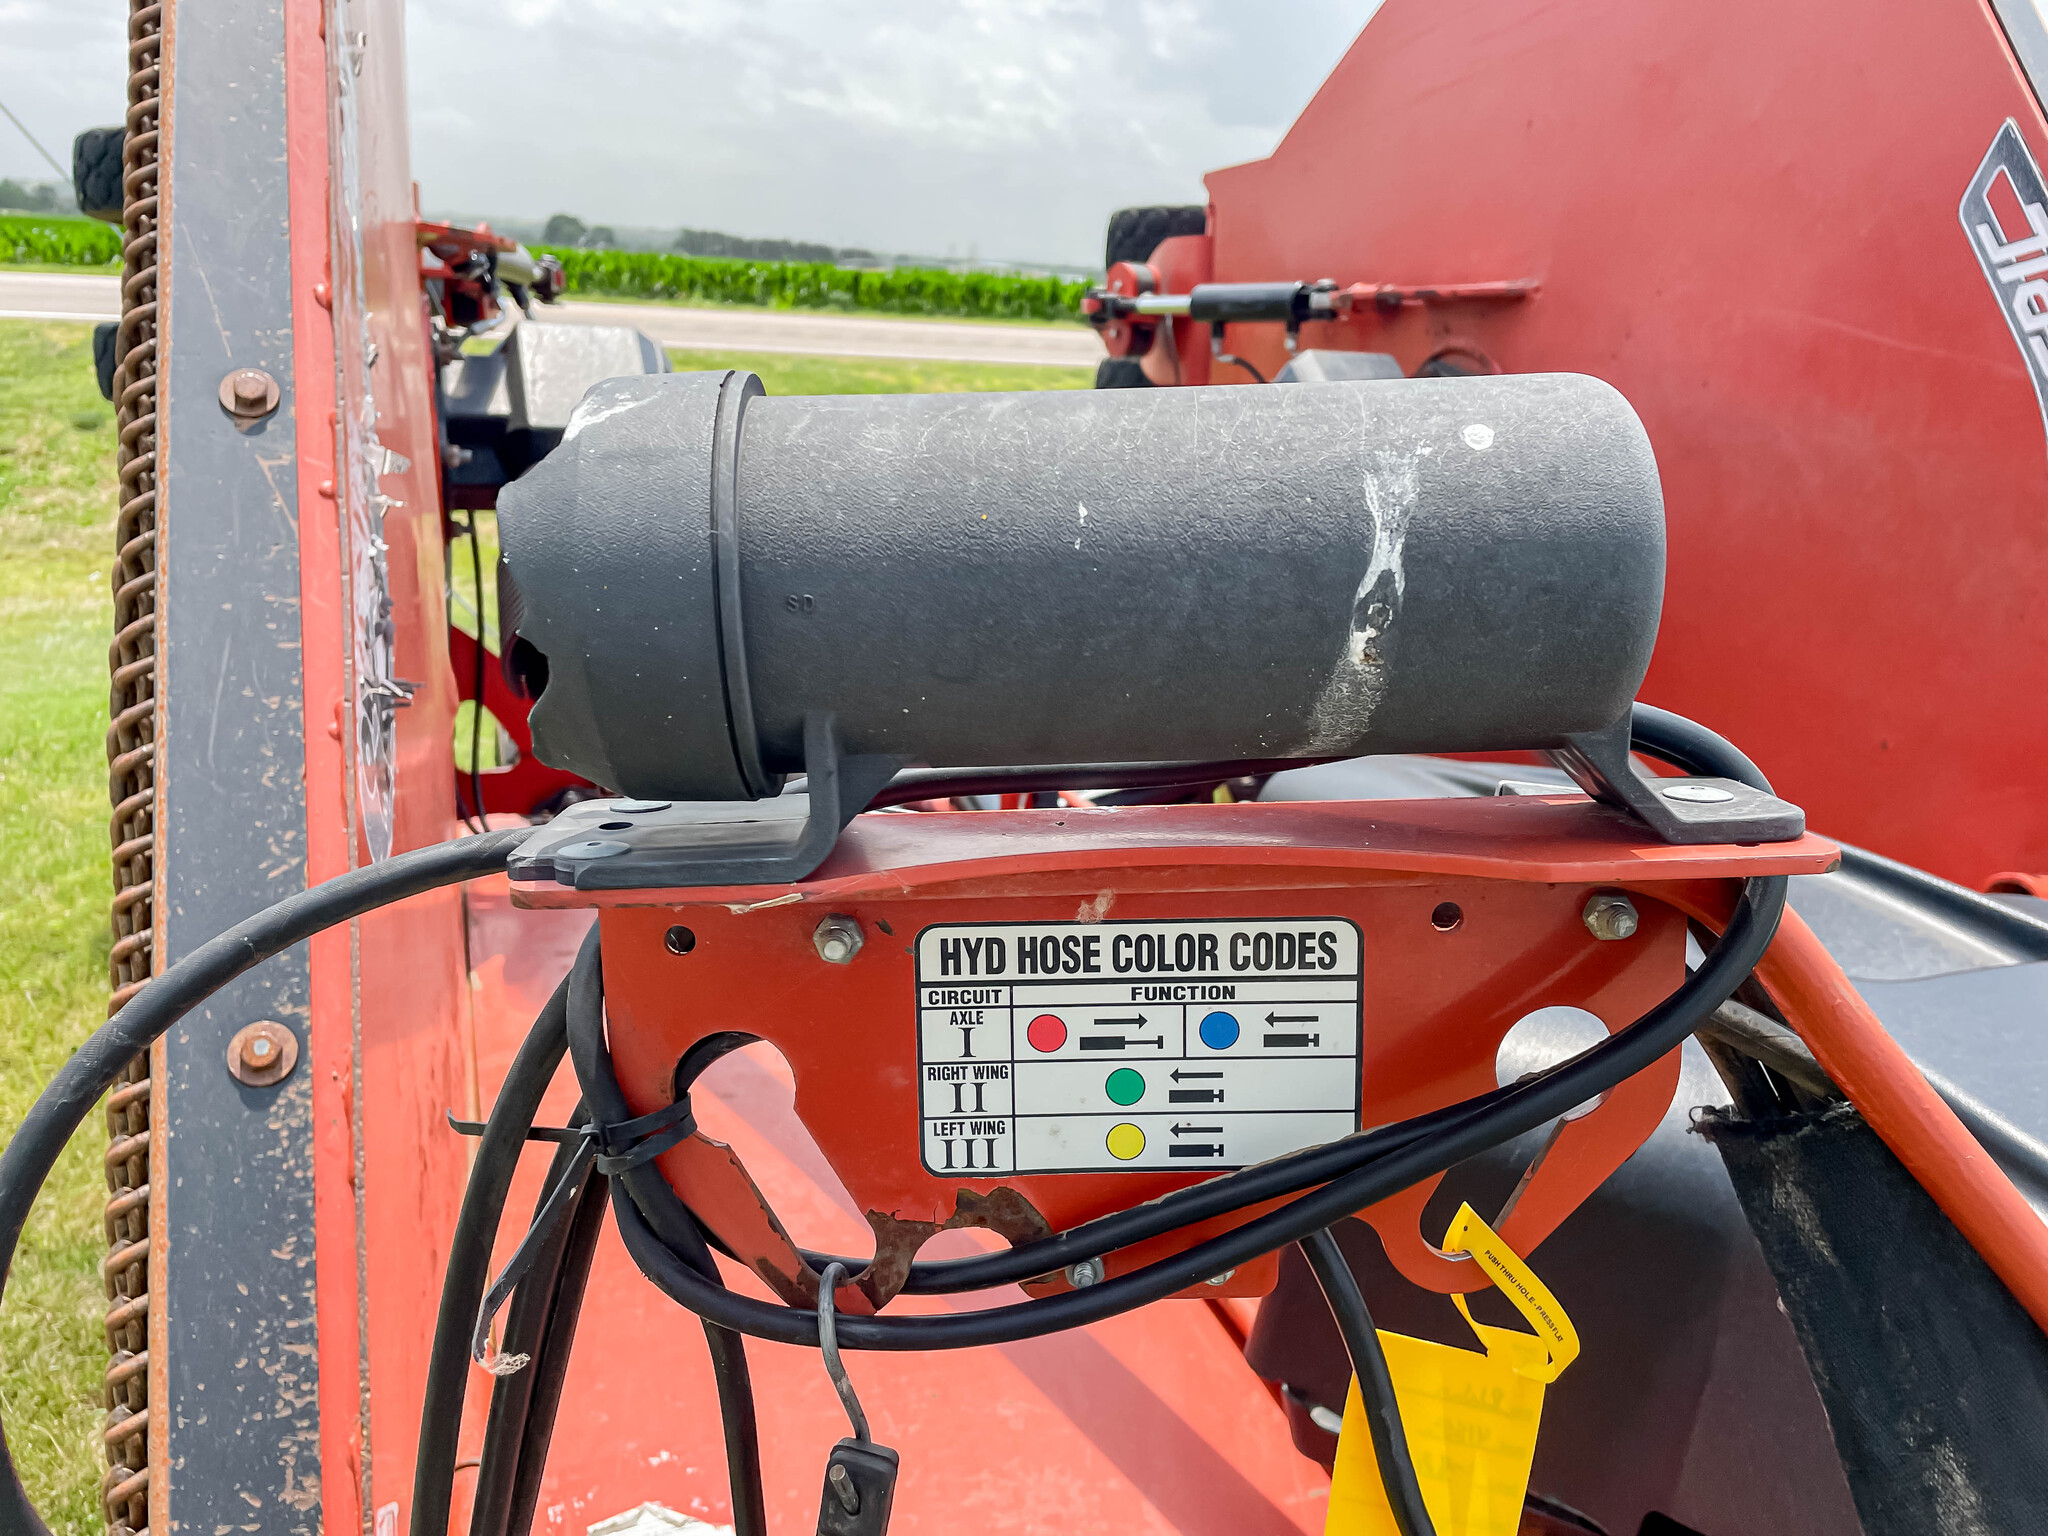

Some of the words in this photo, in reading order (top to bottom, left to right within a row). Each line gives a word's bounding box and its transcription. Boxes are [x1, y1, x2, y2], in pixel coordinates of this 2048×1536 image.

[786, 593, 815, 612] SD
[940, 937, 1007, 976] HYD
[1017, 935, 1101, 975] HOSE
[1112, 933, 1219, 973] COLOR
[1229, 931, 1338, 972] CODES
[928, 988, 1002, 1005] CIRCUIT
[1131, 985, 1236, 1001] FUNCTION
[949, 1010, 984, 1025] AXLE
[958, 1027, 977, 1058] I
[927, 1066, 968, 1081] RIGHT
[973, 1065, 1009, 1080] WING
[949, 1082, 988, 1113] II
[933, 1122, 965, 1137] LEFT
[970, 1120, 1006, 1135] WING
[940, 1138, 1001, 1169] III
[1484, 1249, 1502, 1268] PUSH
[1500, 1264, 1518, 1284] THRU
[1515, 1282, 1536, 1304] HOLE
[1535, 1305, 1555, 1330] PRESS
[1552, 1327, 1564, 1343] FLAT
